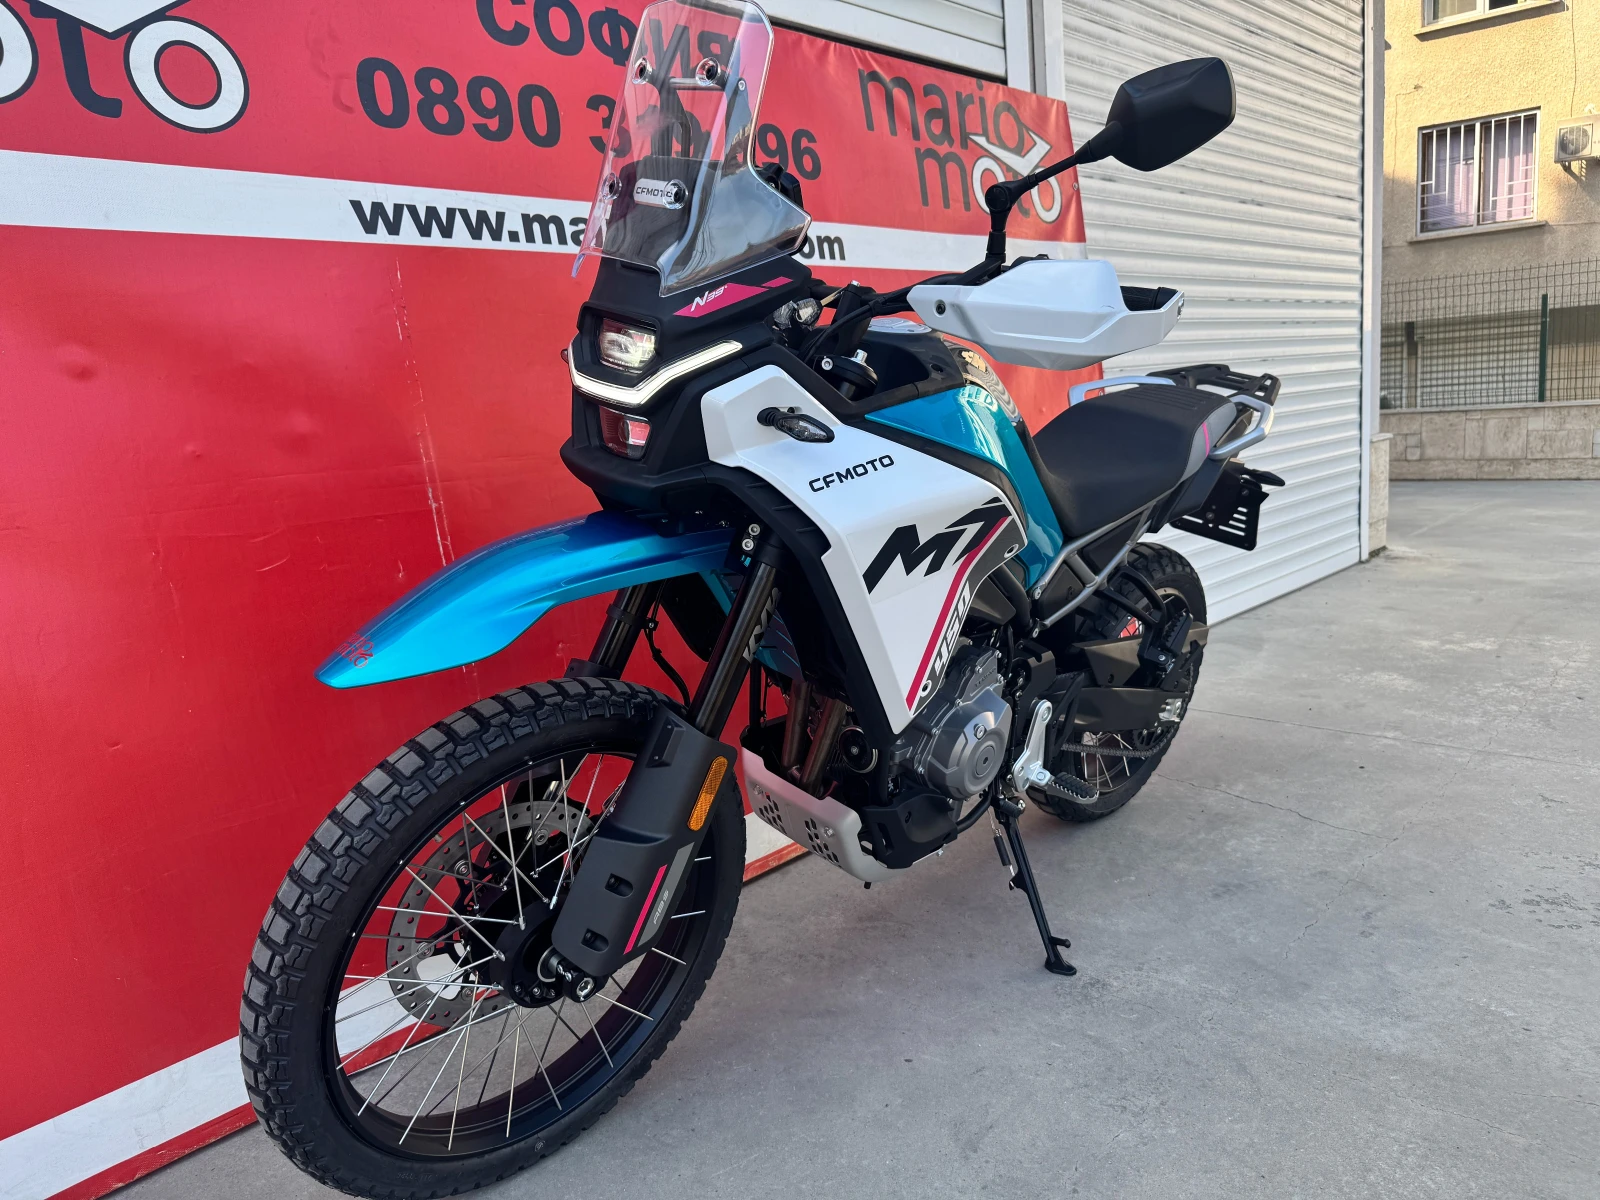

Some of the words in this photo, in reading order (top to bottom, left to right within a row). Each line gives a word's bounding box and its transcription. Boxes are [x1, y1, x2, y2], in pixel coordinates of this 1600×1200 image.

[356, 57, 562, 148] 0890
[857, 67, 1026, 157] mario
[808, 453, 895, 493] CFMOTO
[933, 580, 971, 677] 450
